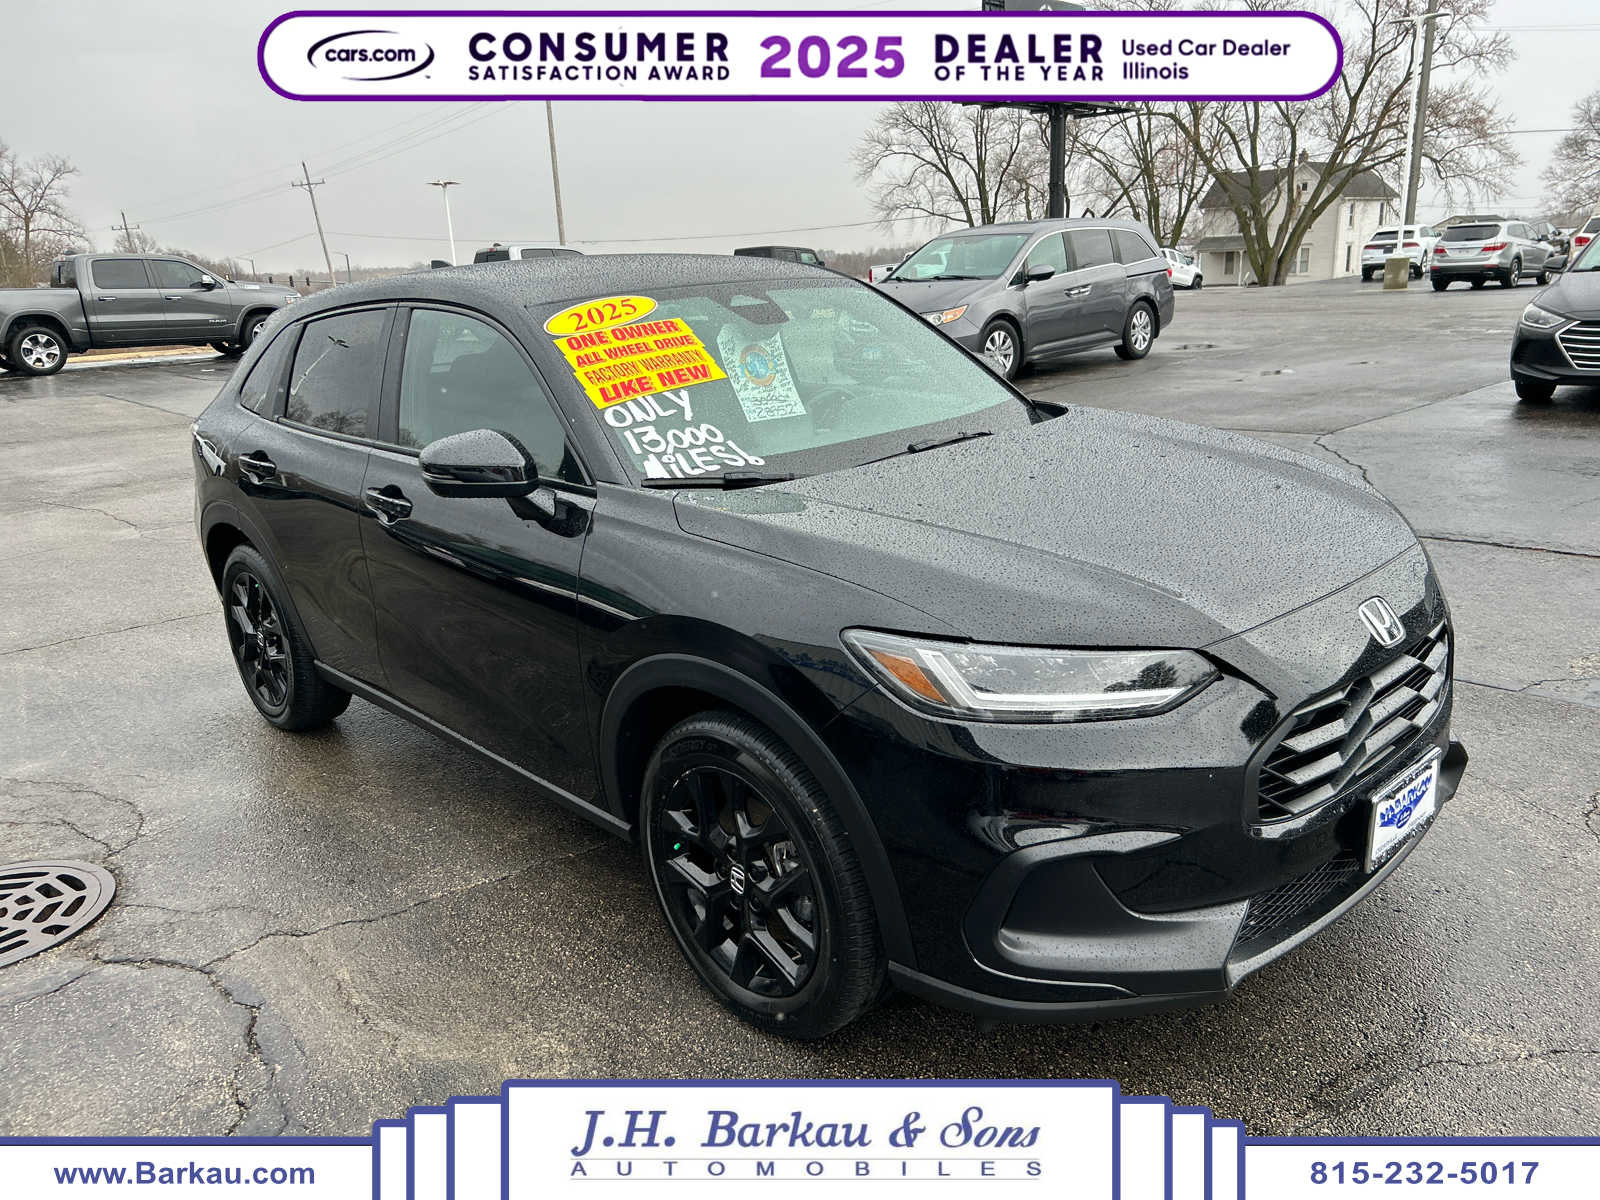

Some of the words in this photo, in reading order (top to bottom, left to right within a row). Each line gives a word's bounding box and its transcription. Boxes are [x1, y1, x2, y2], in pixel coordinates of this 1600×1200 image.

[568, 298, 637, 331] 2025
[566, 331, 611, 350] ONE
[611, 320, 681, 341] OWNER
[576, 350, 603, 368] ALL
[604, 341, 655, 360] WHEEL
[655, 335, 697, 350] DRIVE
[584, 360, 640, 385] FACTORY
[638, 349, 705, 372] WARRANTY
[599, 376, 656, 402] LIKE
[657, 364, 712, 388] NEW
[604, 389, 693, 427] ONLY
[624, 424, 724, 455] 13,000
